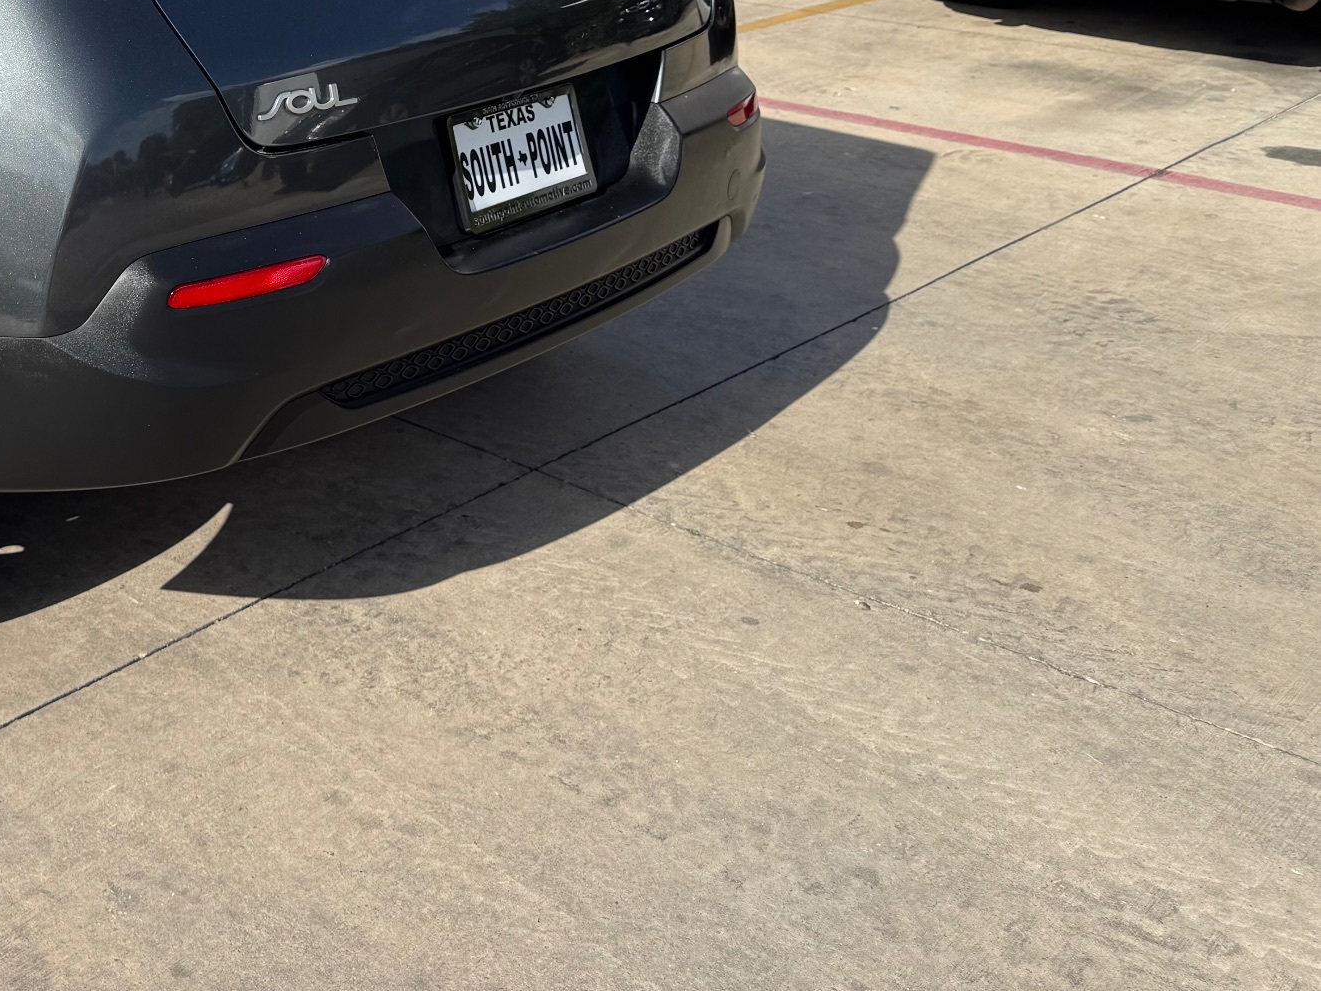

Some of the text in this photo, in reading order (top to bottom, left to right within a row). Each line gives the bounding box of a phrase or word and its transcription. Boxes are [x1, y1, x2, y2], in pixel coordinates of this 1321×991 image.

[257, 83, 359, 121] SOUL
[485, 104, 536, 133] TEXAS
[474, 178, 594, 227] southpointautomotive.com
